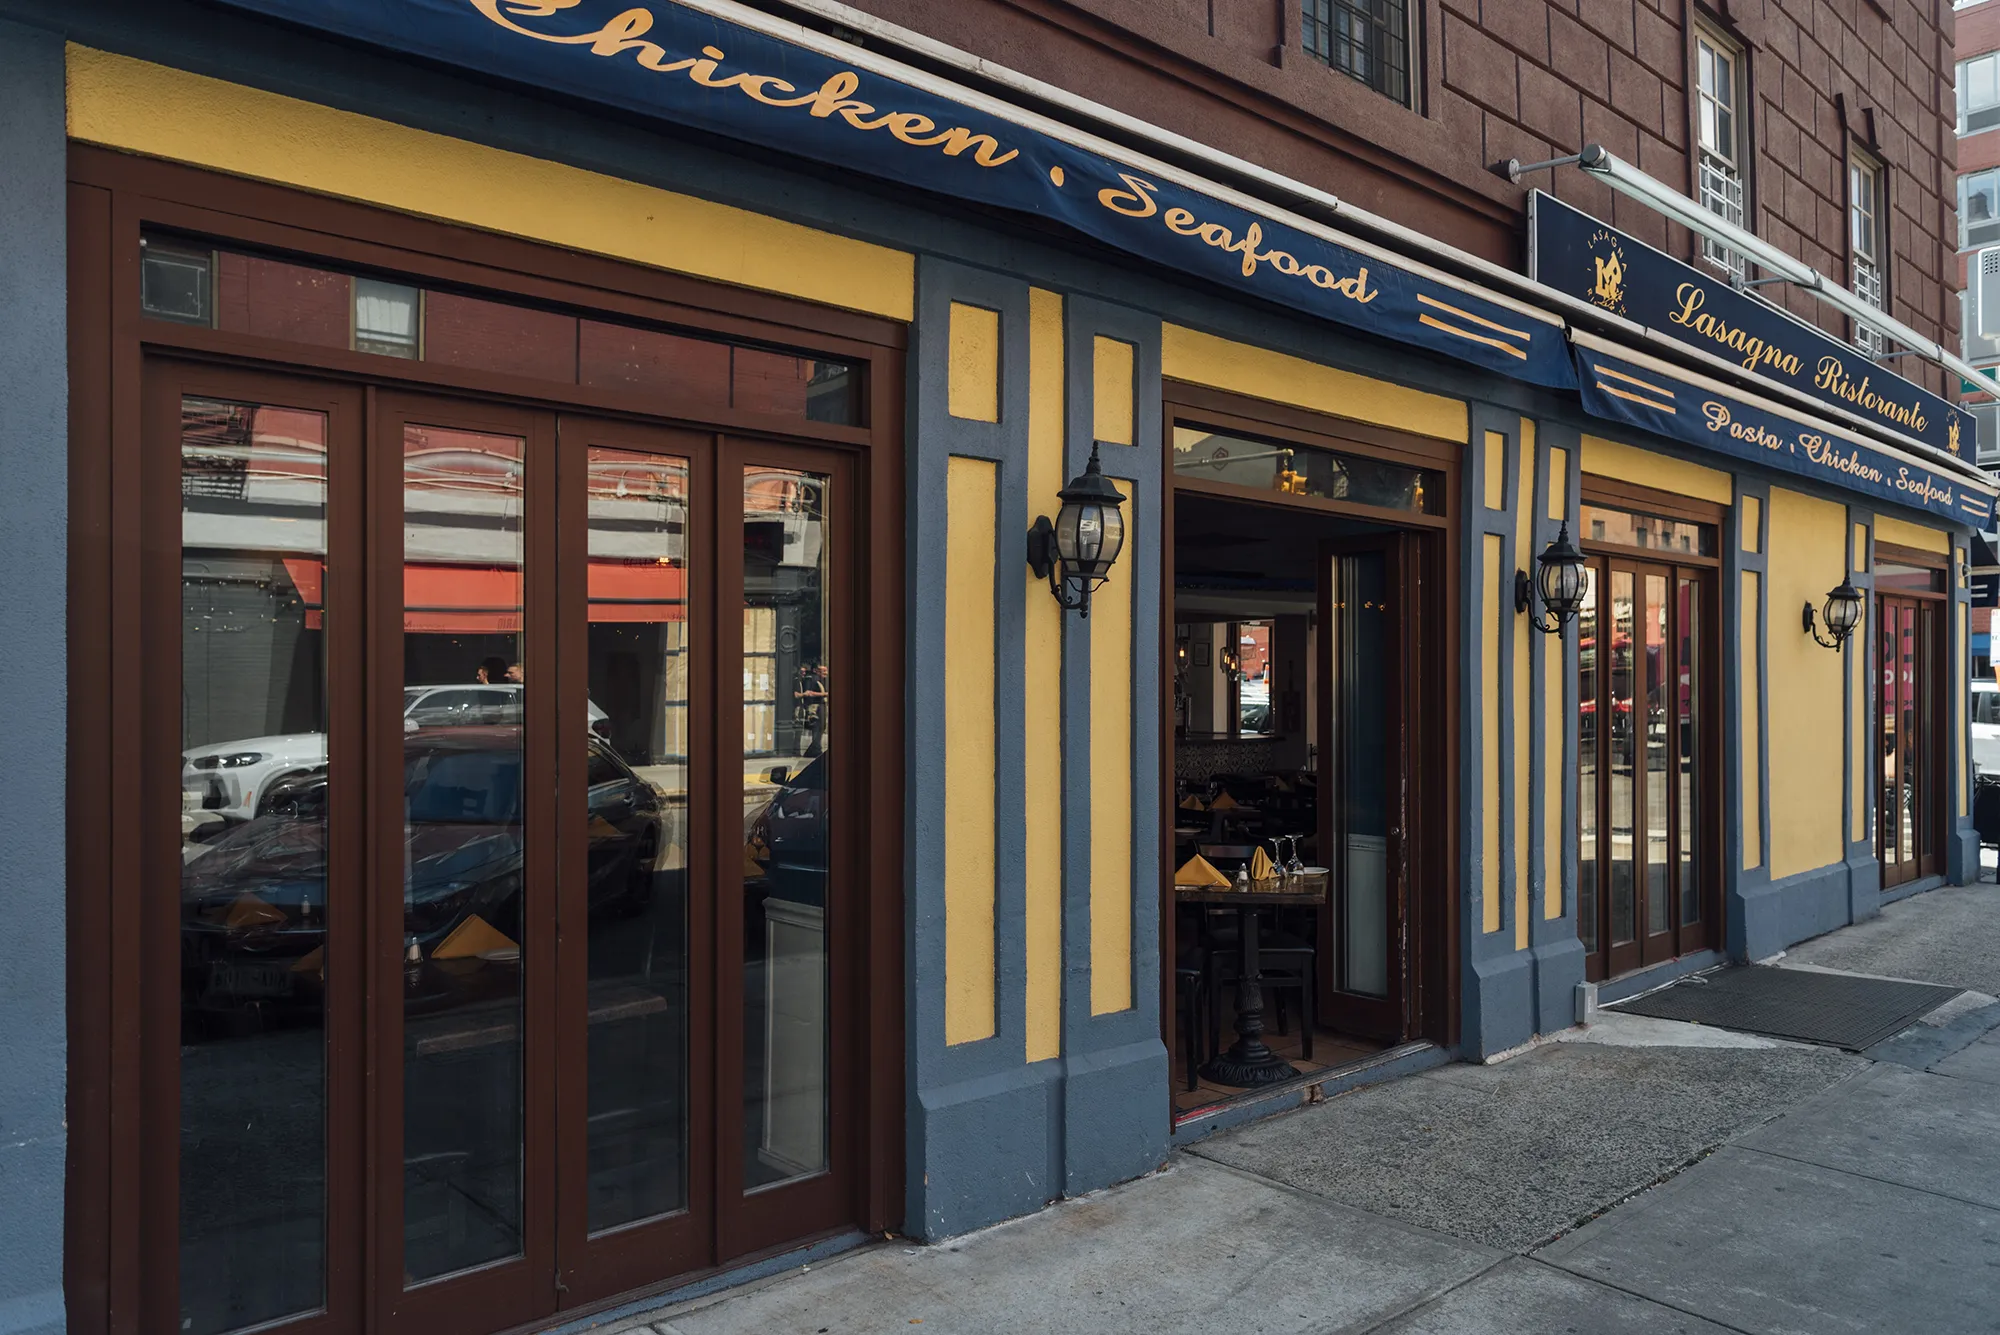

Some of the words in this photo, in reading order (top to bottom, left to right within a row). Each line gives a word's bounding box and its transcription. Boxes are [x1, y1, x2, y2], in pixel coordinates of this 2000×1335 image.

[1097, 173, 1379, 303] Seafood
[1668, 282, 1804, 376] Lasagna
[1814, 355, 1929, 432] Ristorante
[1701, 400, 1783, 450] Pasta
[1799, 433, 1883, 484] Chicken
[1895, 466, 1954, 506] Seafood
